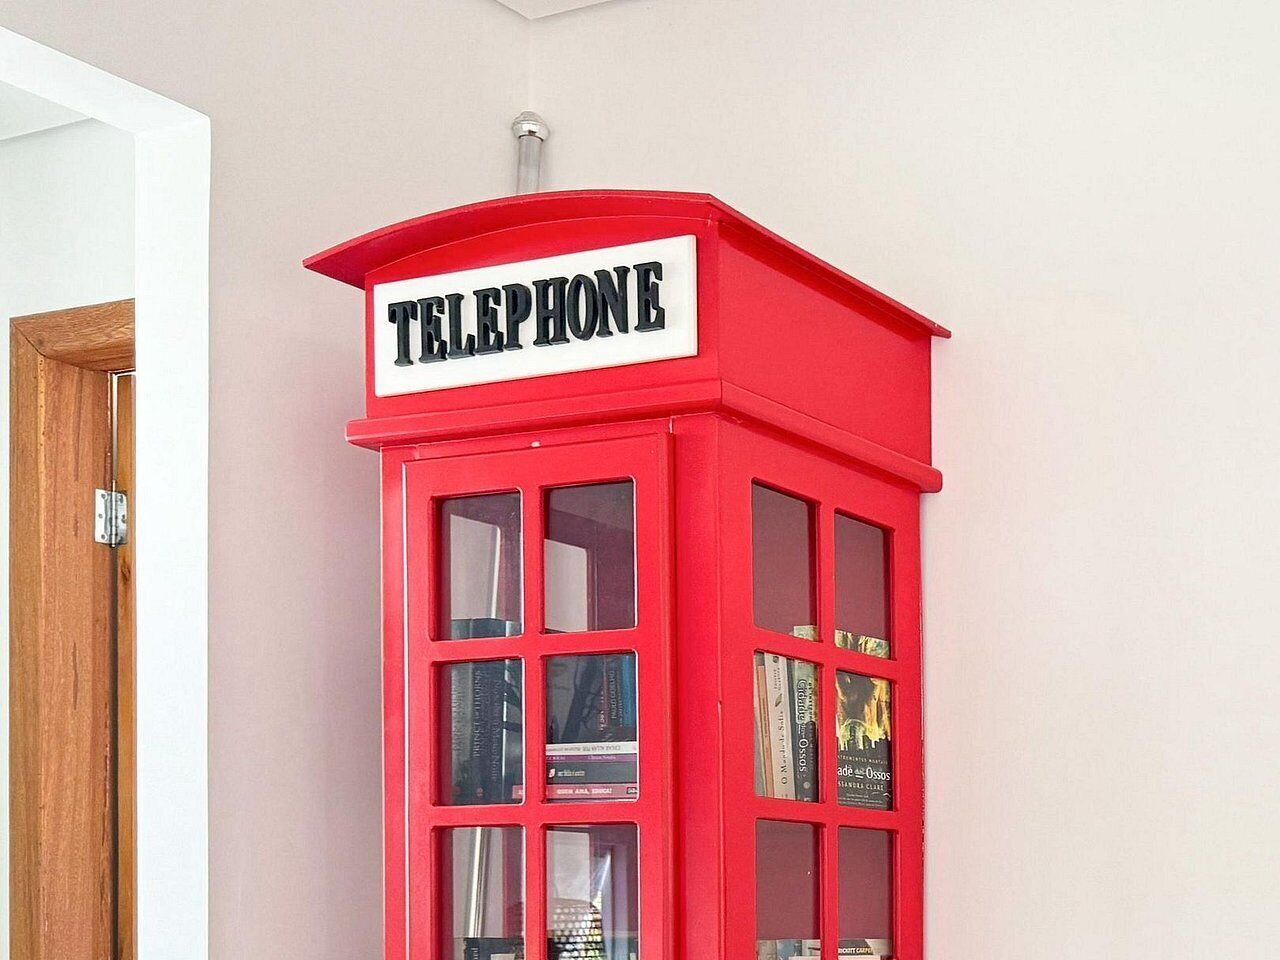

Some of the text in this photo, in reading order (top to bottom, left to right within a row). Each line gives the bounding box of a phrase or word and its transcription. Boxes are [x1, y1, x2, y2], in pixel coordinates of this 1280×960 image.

[388, 261, 666, 367] TELEPHONE
[797, 679, 807, 721] Cidade
[799, 738, 809, 772] Ossos
[837, 765, 853, 777] ade
[866, 767, 891, 780] Ossos
